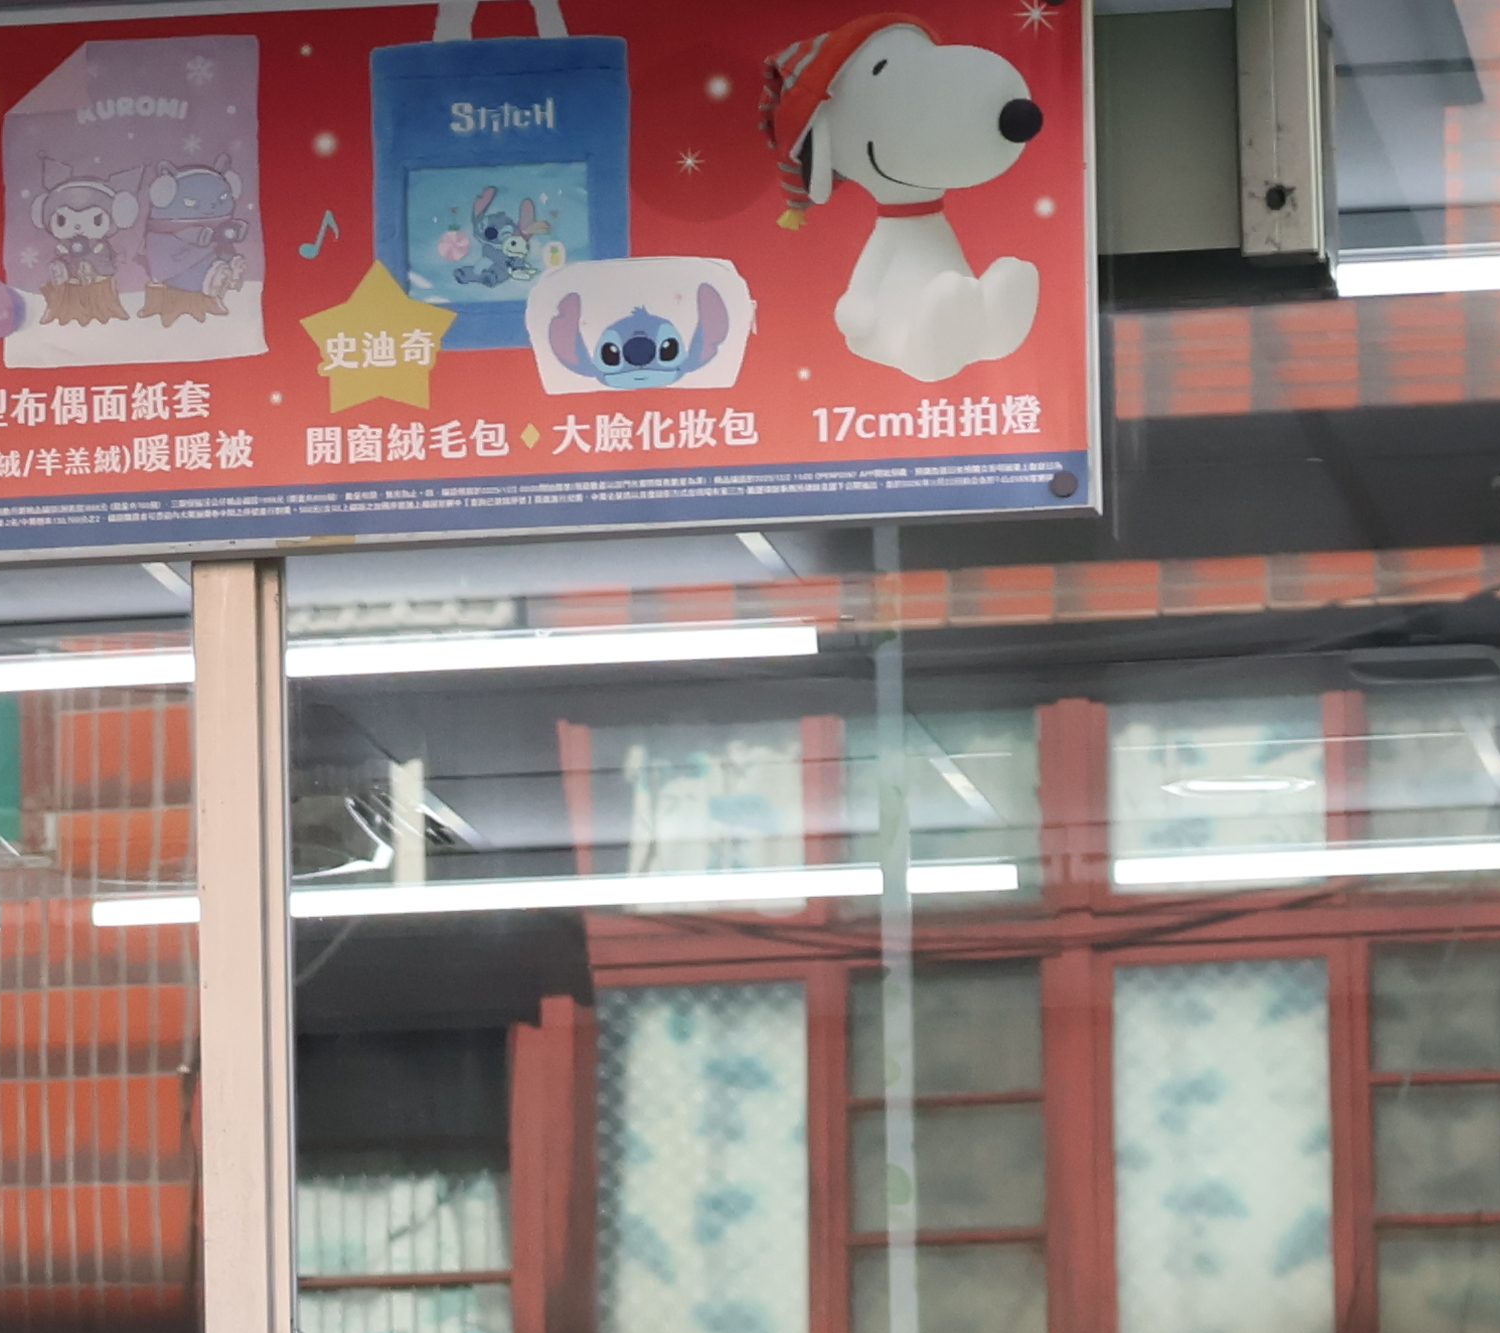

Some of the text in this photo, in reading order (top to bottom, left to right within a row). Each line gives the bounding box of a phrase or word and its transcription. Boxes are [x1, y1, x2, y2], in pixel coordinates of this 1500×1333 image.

[321, 333, 436, 371] 史迪奇
[305, 408, 760, 467] 開窗絨毛包 大臉化妝包
[810, 398, 1043, 446] 17cm拍拍燈
